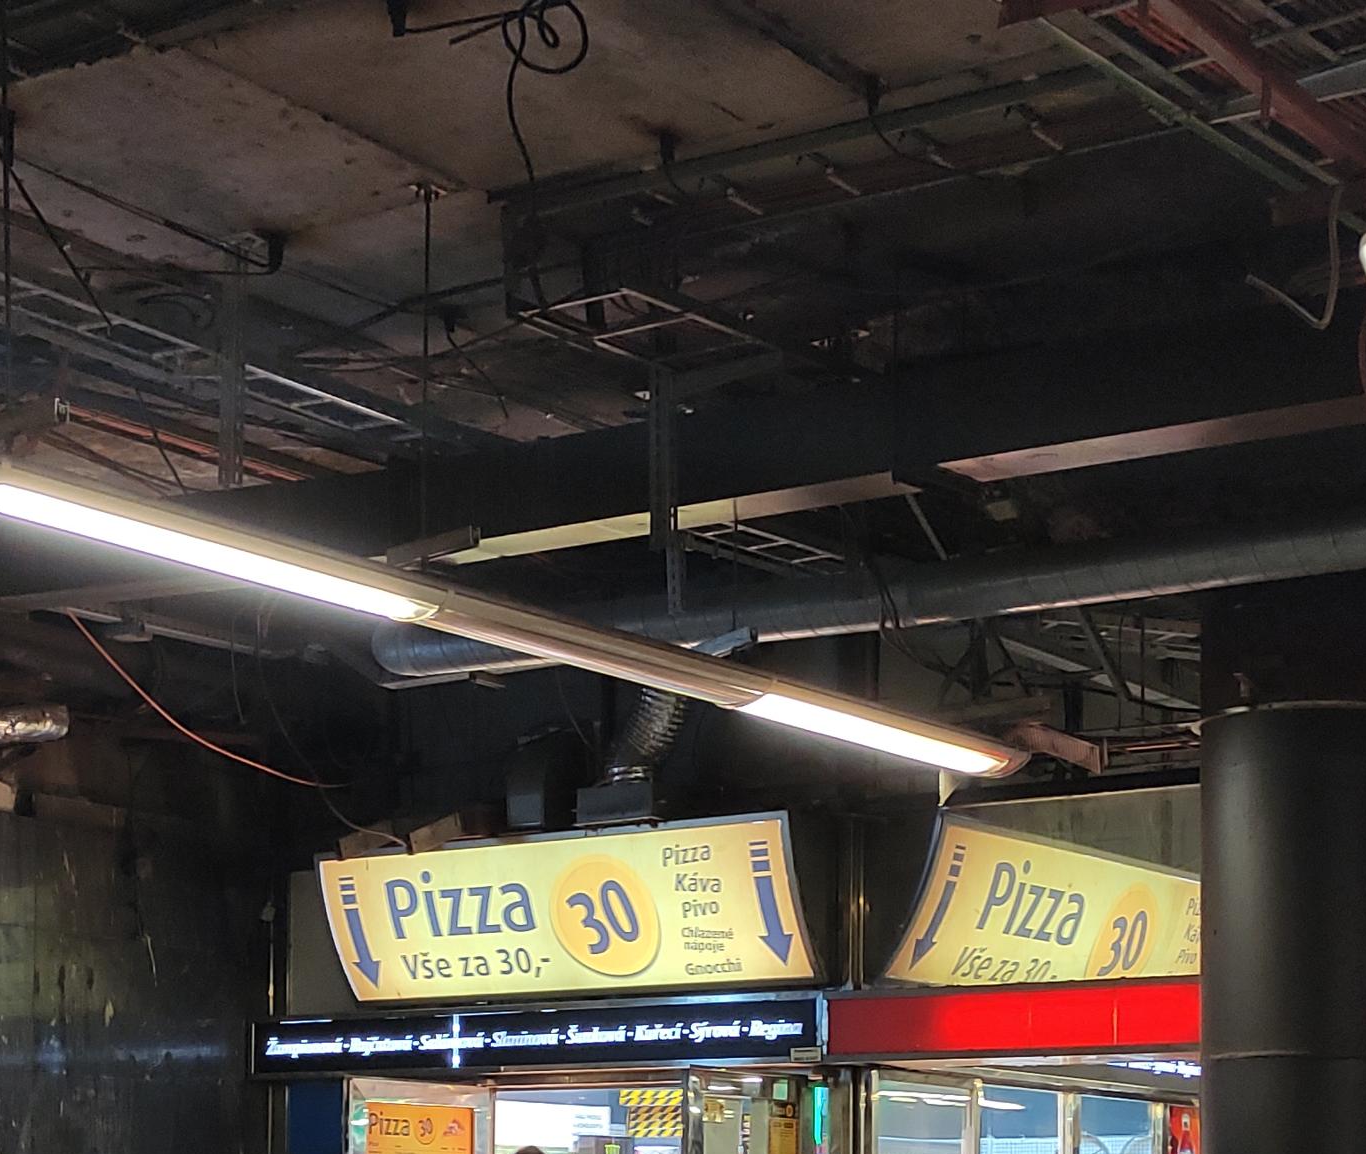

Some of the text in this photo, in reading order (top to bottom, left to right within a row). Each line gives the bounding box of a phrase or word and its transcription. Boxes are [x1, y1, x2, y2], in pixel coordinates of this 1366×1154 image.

[661, 844, 711, 867] Pizza
[675, 872, 722, 893] Káva
[385, 870, 537, 939] Pizza
[566, 880, 639, 954] 30
[682, 899, 720, 918] Pivo
[976, 860, 1086, 946] Pizza
[1097, 910, 1148, 978] 30
[400, 948, 551, 980] Vše za 30,-
[951, 946, 992, 980] Vše
[988, 960, 1020, 982] za
[368, 1112, 411, 1137] Pizza
